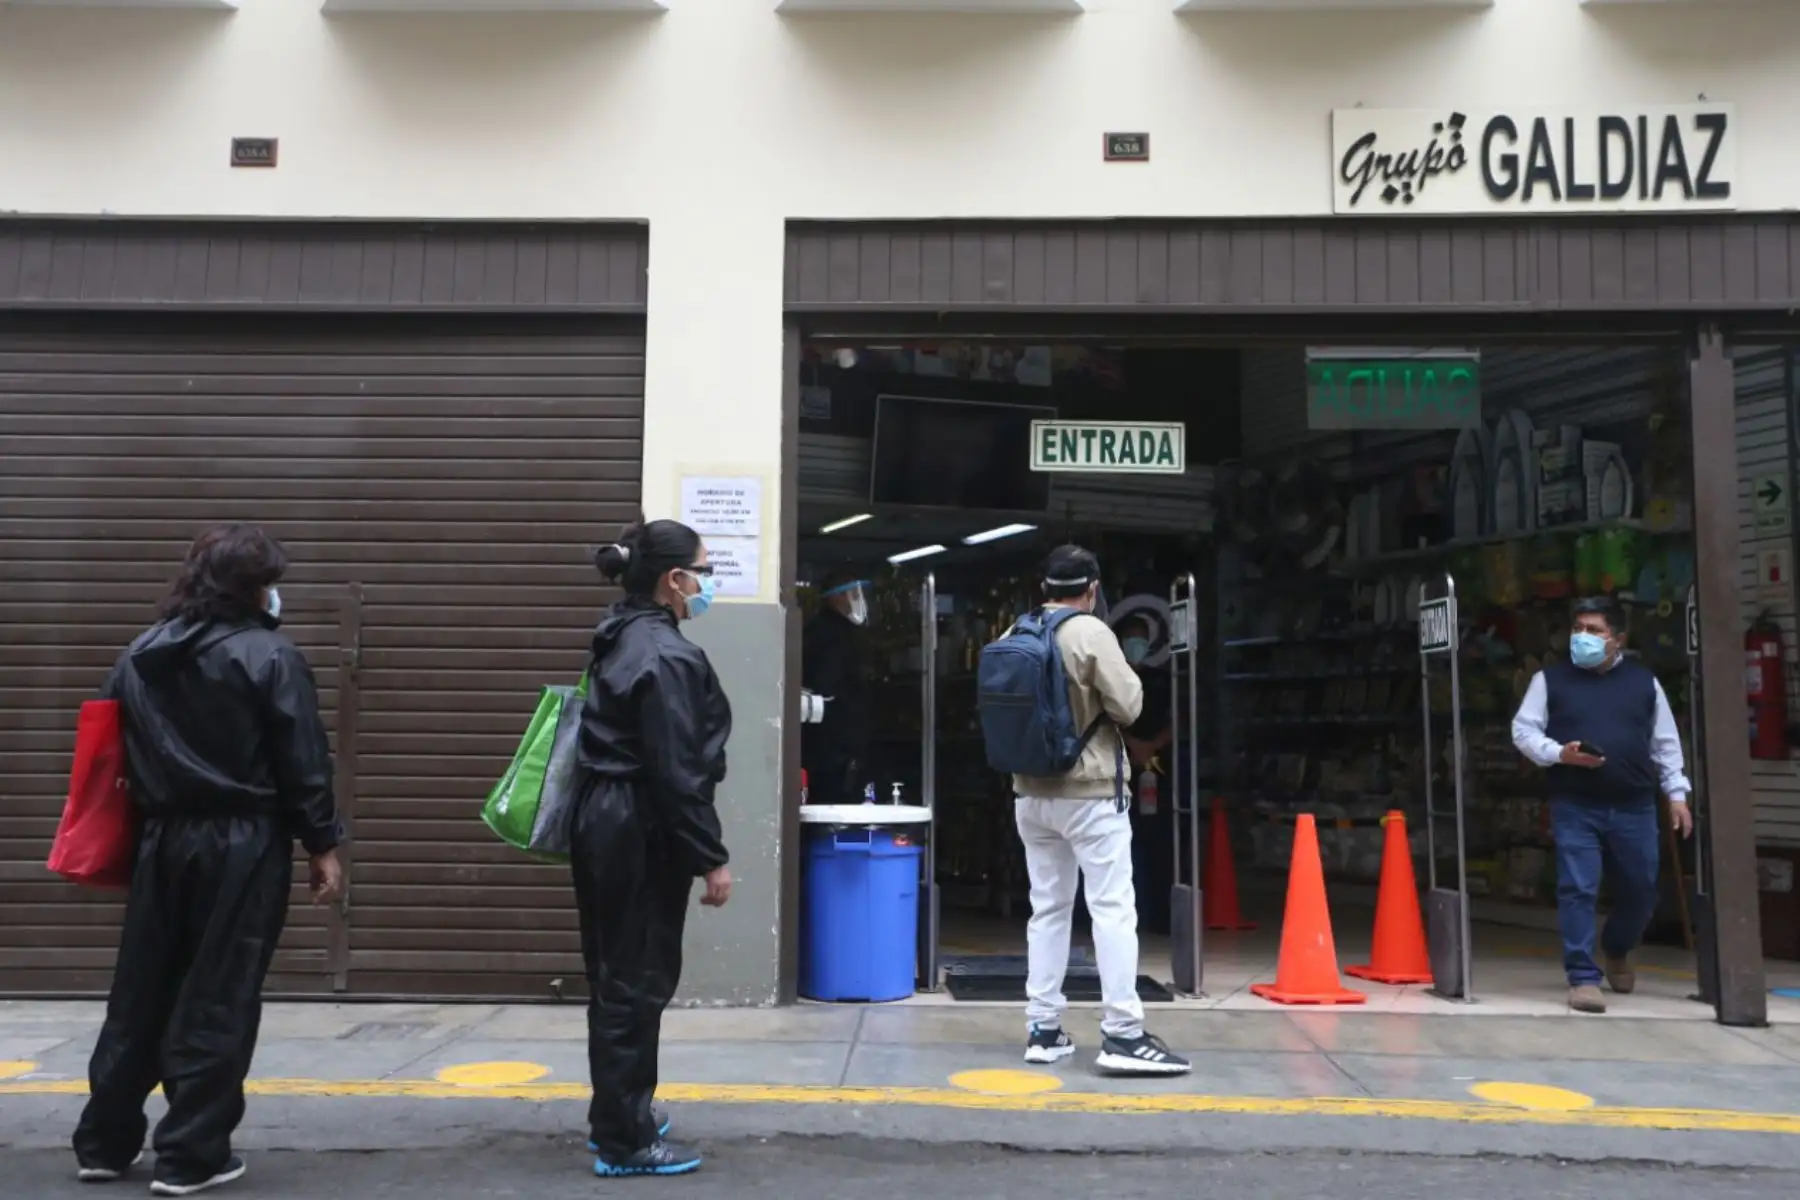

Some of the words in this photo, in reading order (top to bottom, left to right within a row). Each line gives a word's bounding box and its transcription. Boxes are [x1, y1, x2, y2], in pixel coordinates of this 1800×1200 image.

[1340, 131, 1467, 206] Grupo
[1481, 113, 1731, 202] GALDIAZ
[1040, 427, 1175, 466] ENTRADA
[699, 498, 743, 506] APERTURA
